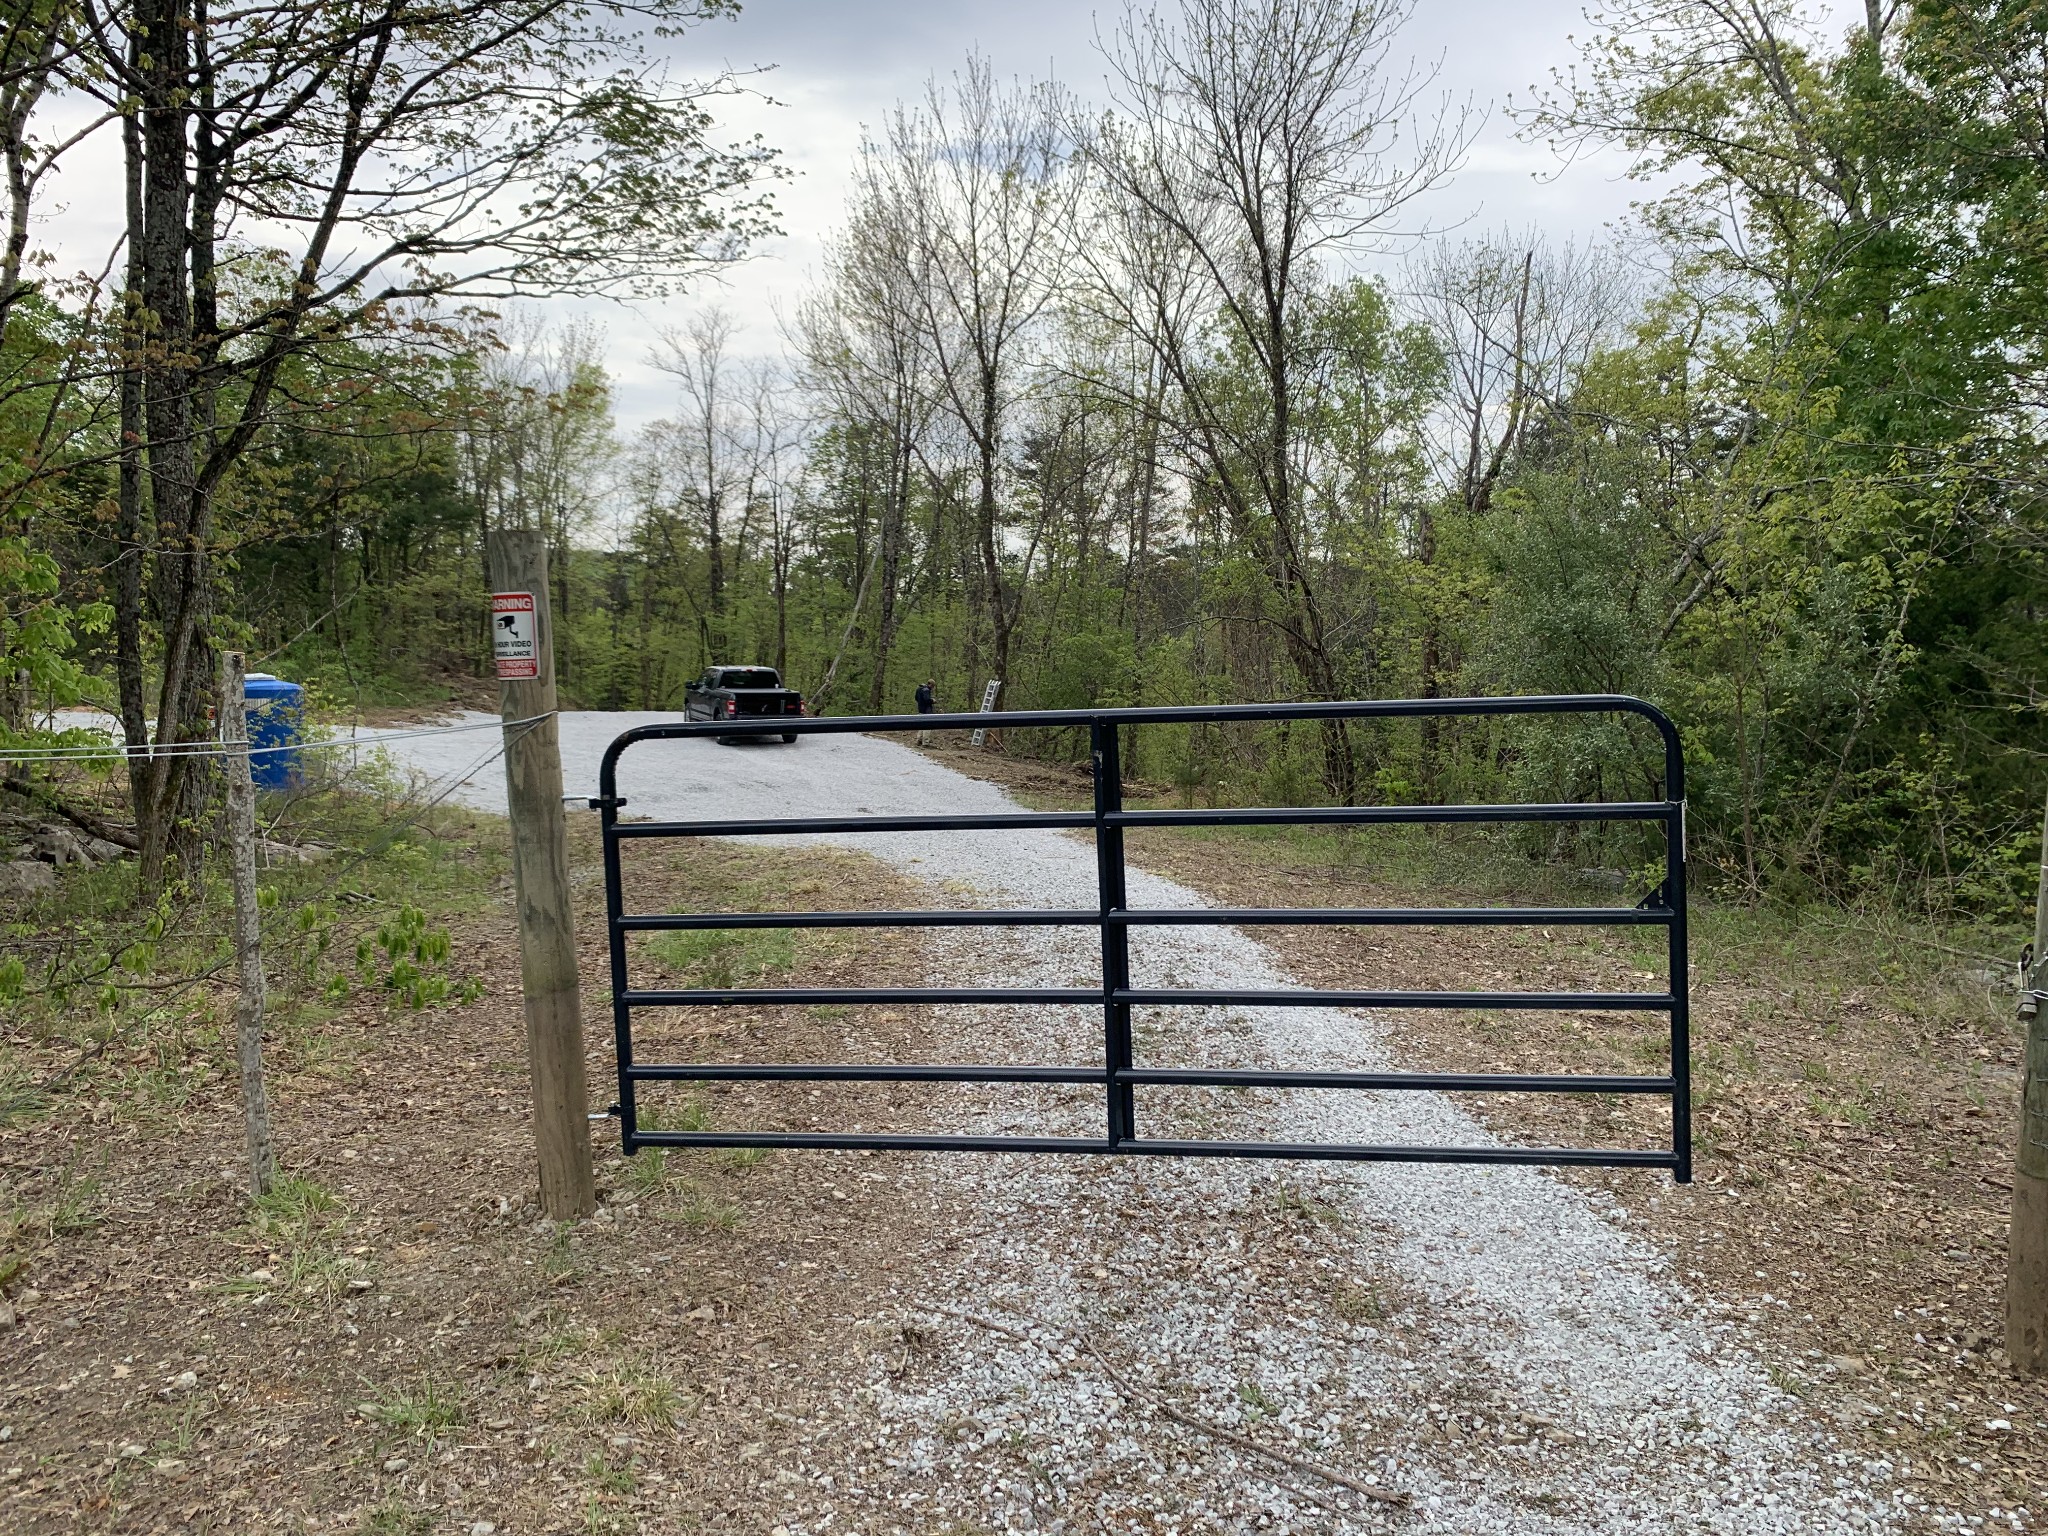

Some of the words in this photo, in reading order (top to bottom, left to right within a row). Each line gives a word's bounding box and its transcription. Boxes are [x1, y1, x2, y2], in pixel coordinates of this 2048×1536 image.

[493, 598, 531, 610] ARNING
[511, 640, 532, 648] VIDEO
[506, 660, 535, 668] PROPERTY
